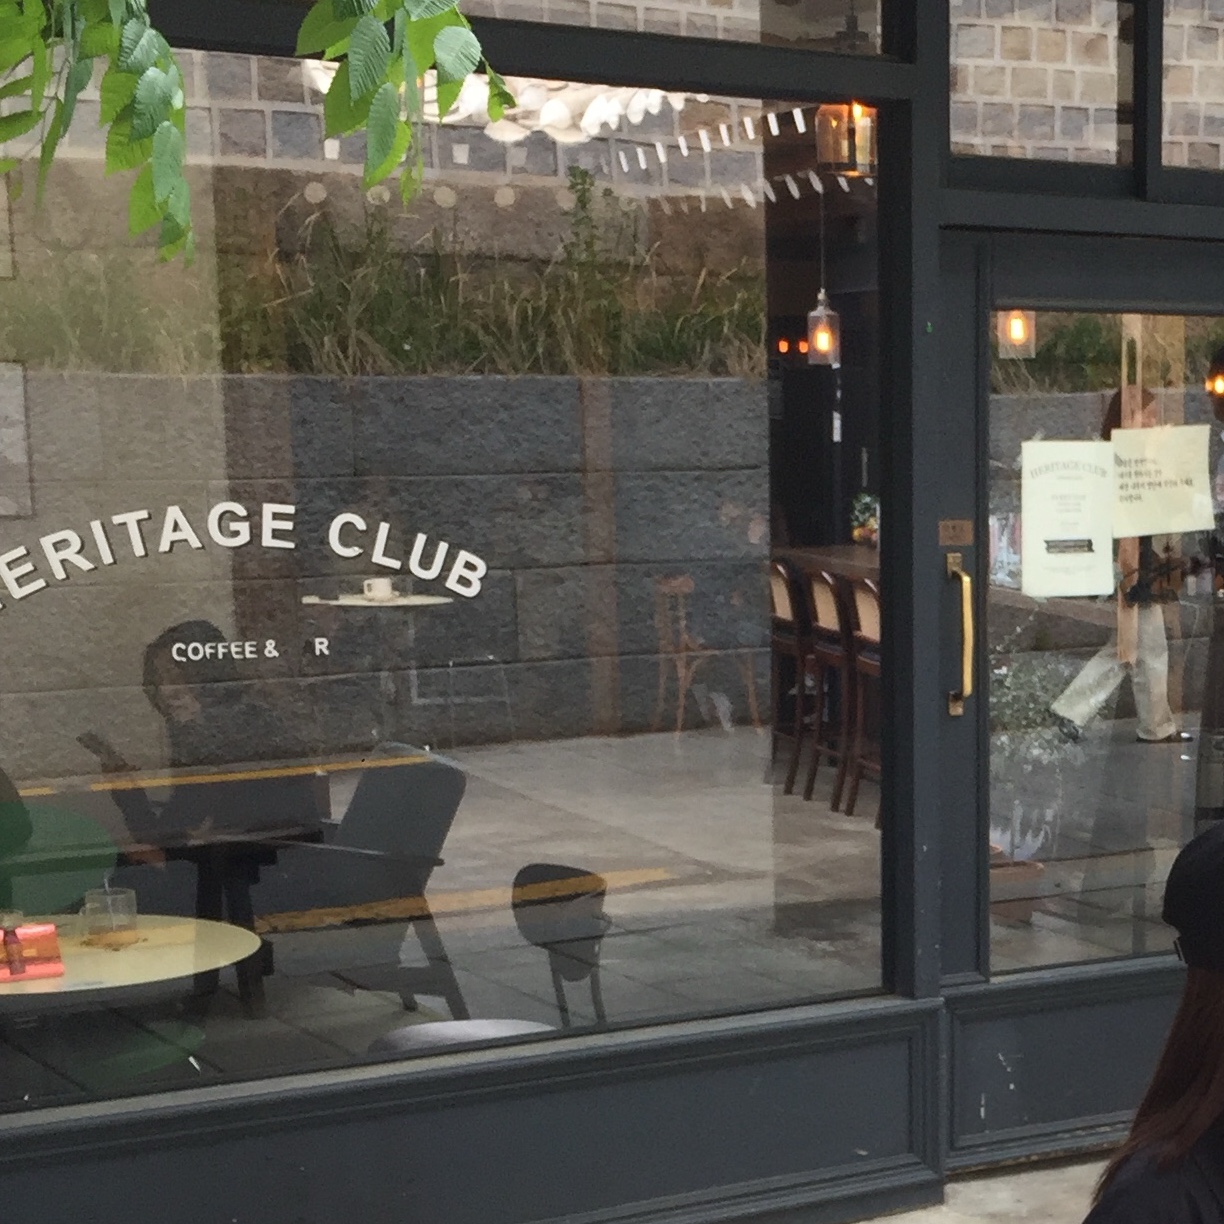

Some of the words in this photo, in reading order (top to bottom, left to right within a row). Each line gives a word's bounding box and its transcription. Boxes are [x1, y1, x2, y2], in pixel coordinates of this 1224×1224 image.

[0, 501, 296, 608] ERITAGE
[328, 512, 488, 598] CLUB
[171, 640, 258, 662] COFFEE
[264, 639, 280, 659] &
